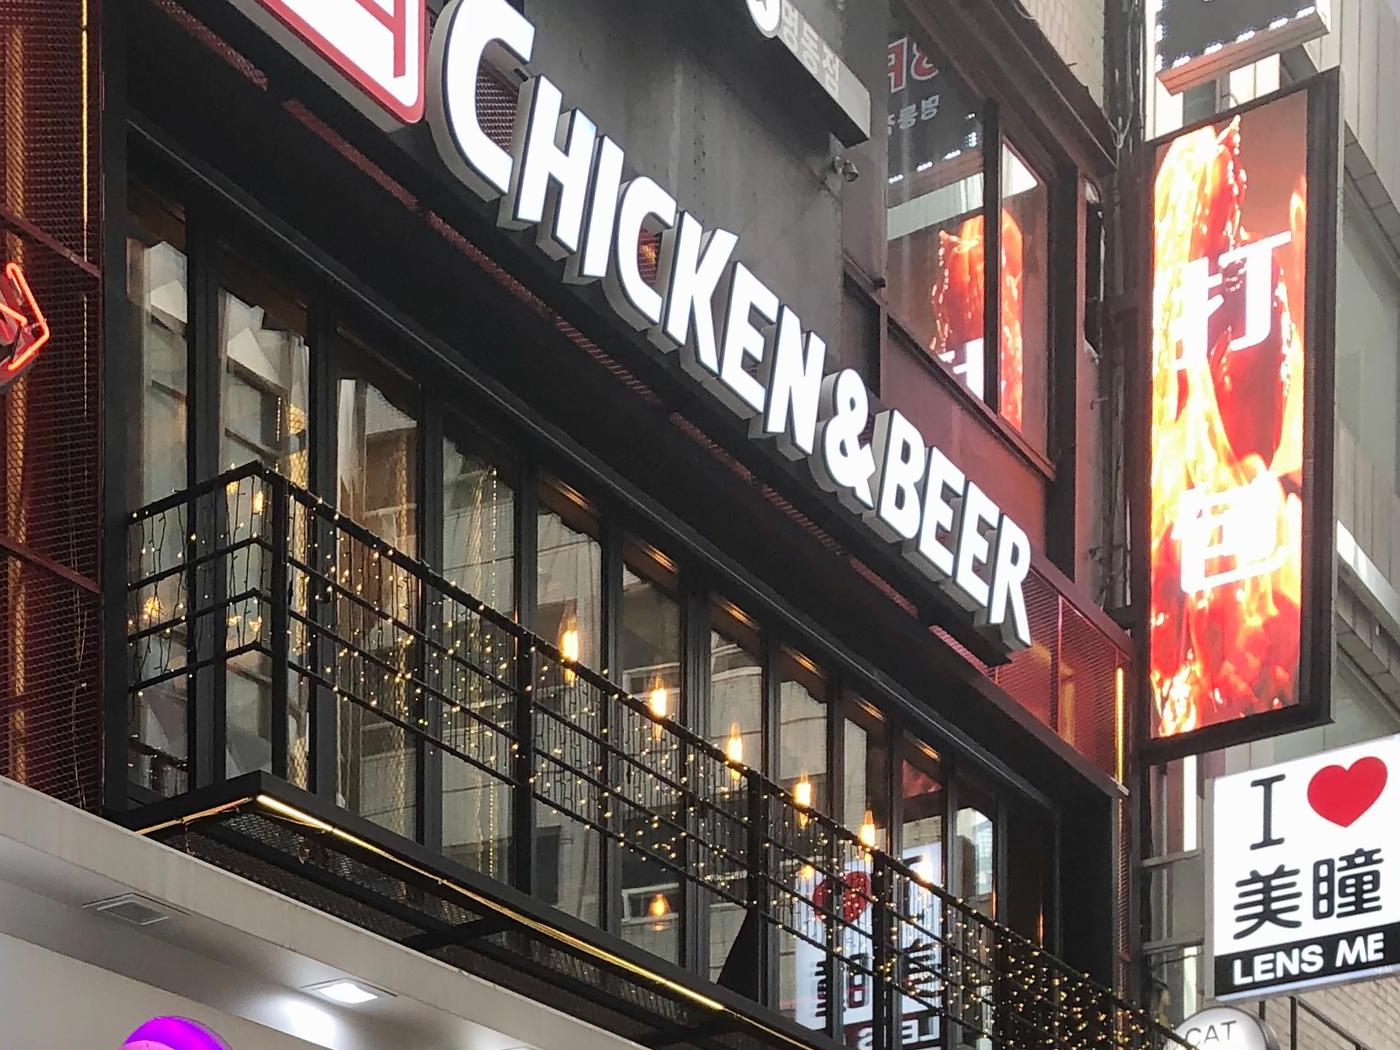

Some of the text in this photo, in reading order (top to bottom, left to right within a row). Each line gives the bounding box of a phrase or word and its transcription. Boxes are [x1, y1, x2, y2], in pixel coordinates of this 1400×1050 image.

[1249, 772, 1287, 851] I
[1233, 846, 1384, 941] 美瞳
[1233, 931, 1385, 987] LENS ME
[1184, 1020, 1238, 1048] CAT
